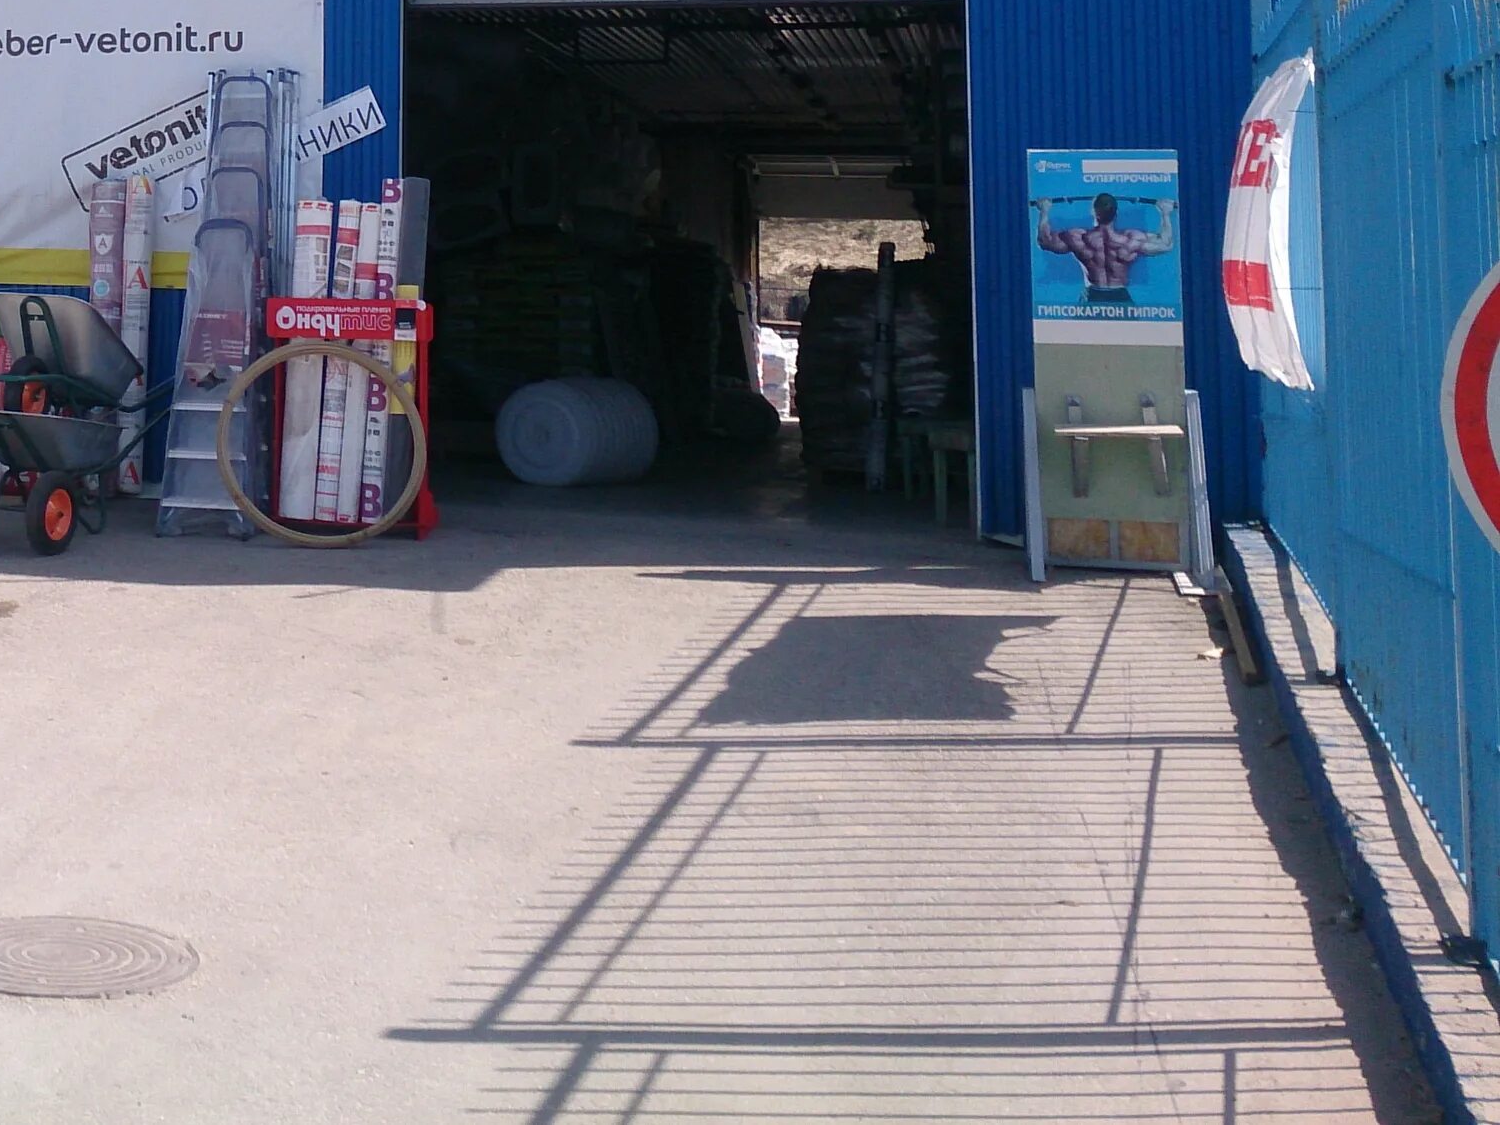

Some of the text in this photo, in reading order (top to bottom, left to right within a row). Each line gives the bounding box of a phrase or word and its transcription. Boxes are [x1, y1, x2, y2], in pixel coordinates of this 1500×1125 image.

[84, 104, 208, 180] vetonit
[1037, 304, 1177, 319] ГИПСОКАРТОН ГИПРОК
